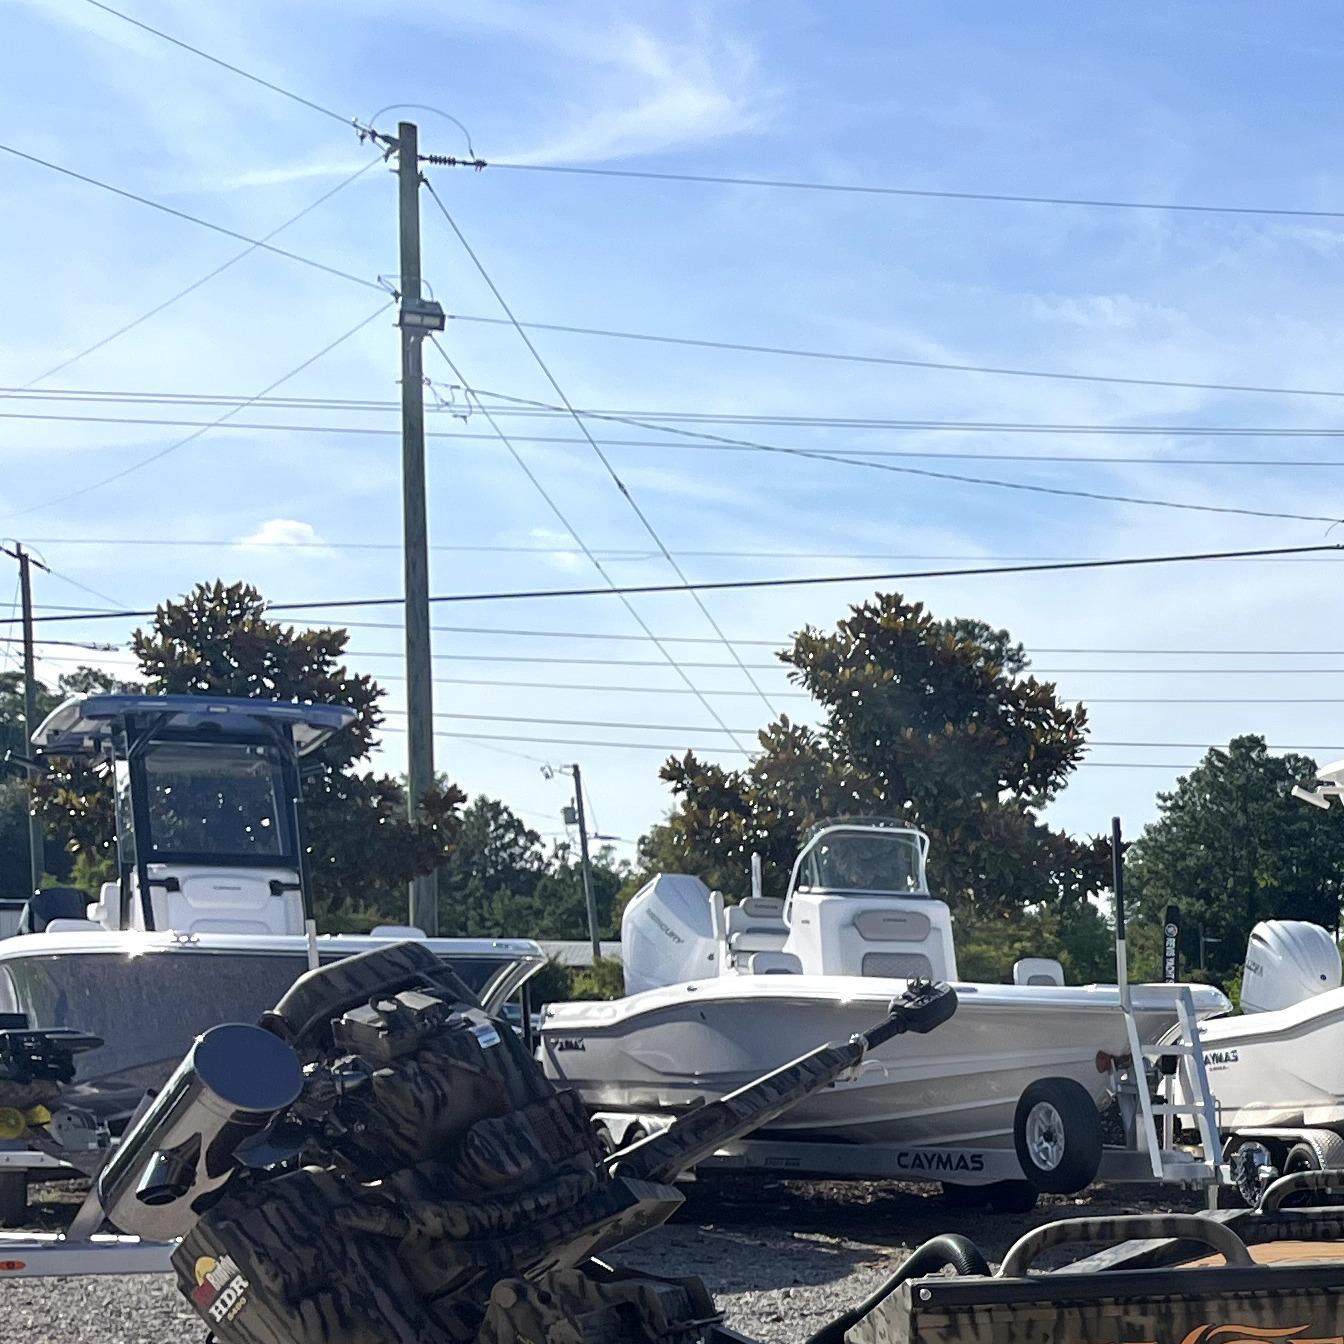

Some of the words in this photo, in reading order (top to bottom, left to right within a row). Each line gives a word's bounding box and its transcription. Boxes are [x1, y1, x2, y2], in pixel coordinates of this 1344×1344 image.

[1203, 1049, 1239, 1065] AYMAS
[896, 1152, 985, 1172] CAYMAS
[208, 1274, 250, 1323] HDR
